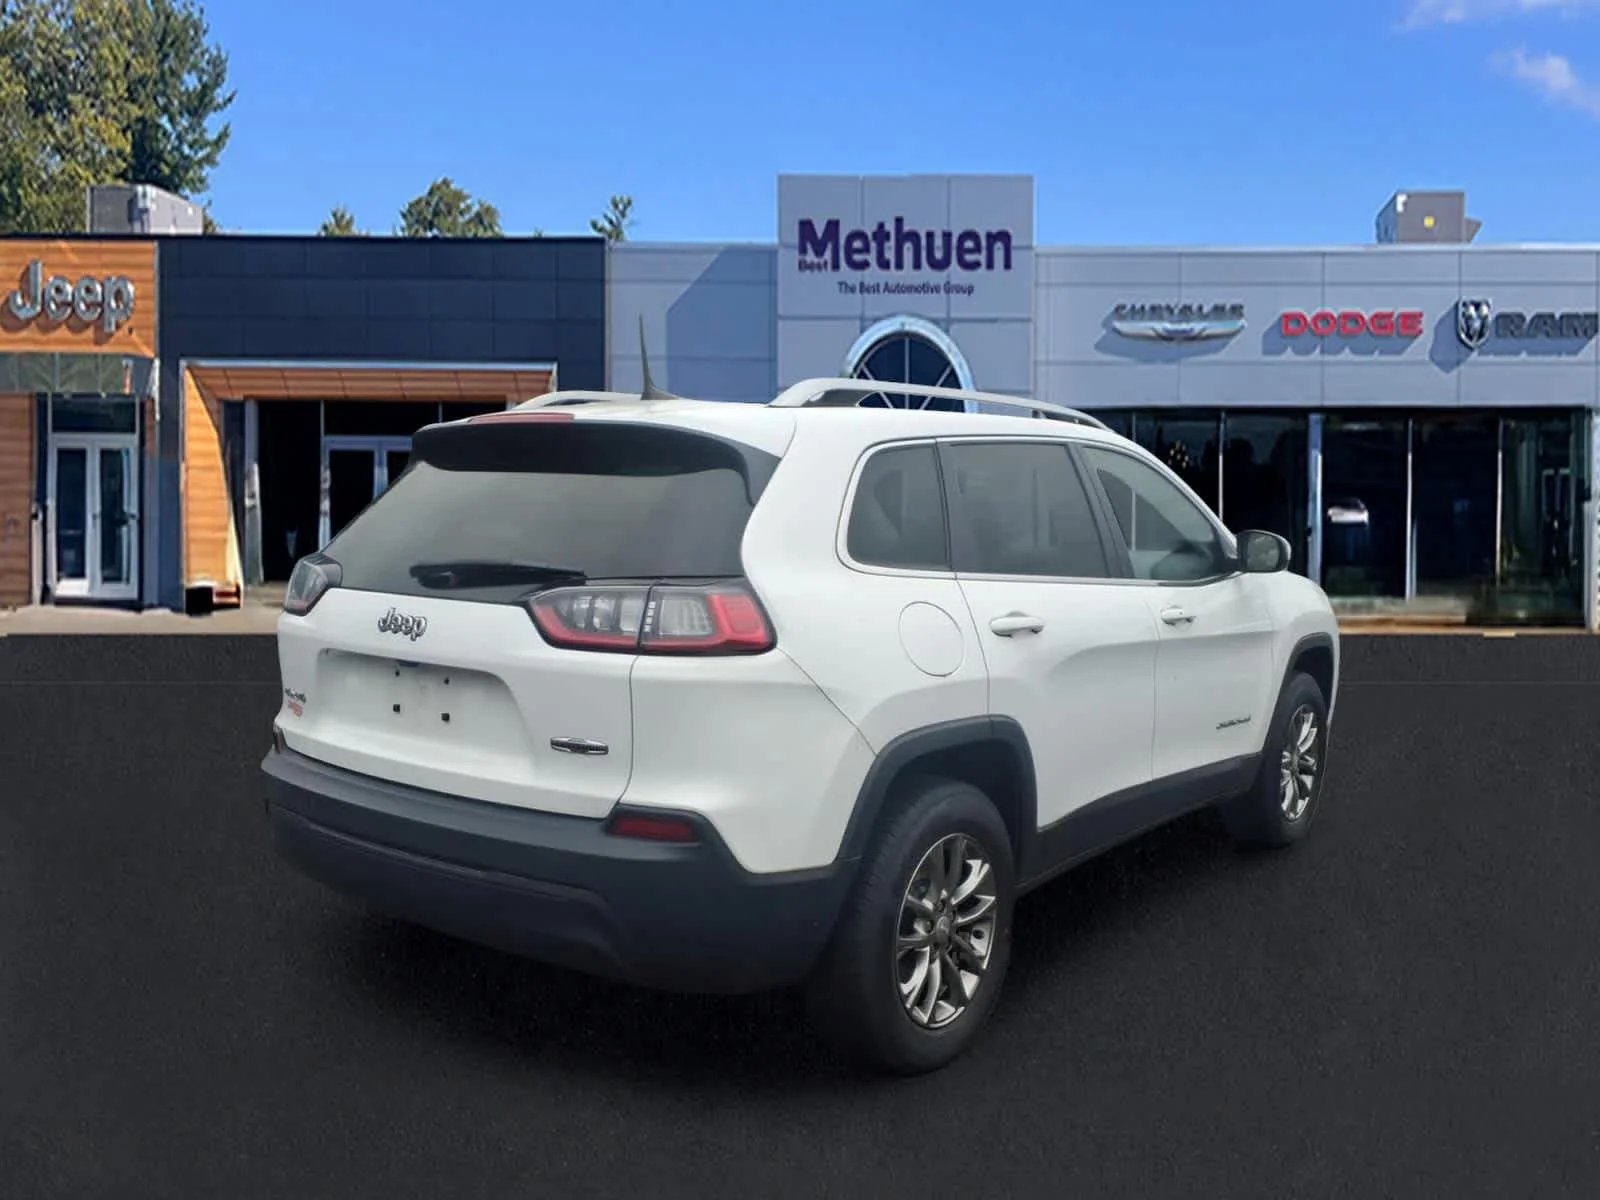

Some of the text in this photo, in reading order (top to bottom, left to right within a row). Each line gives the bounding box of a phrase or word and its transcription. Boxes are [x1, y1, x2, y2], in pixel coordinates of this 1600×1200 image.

[798, 216, 1012, 272] Methuen
[7, 260, 135, 333] Jeep
[837, 281, 974, 296] The Best Automotive Group
[1281, 311, 1424, 336] DODGE
[1495, 311, 1598, 339] RAM
[377, 607, 428, 641] Jeep
